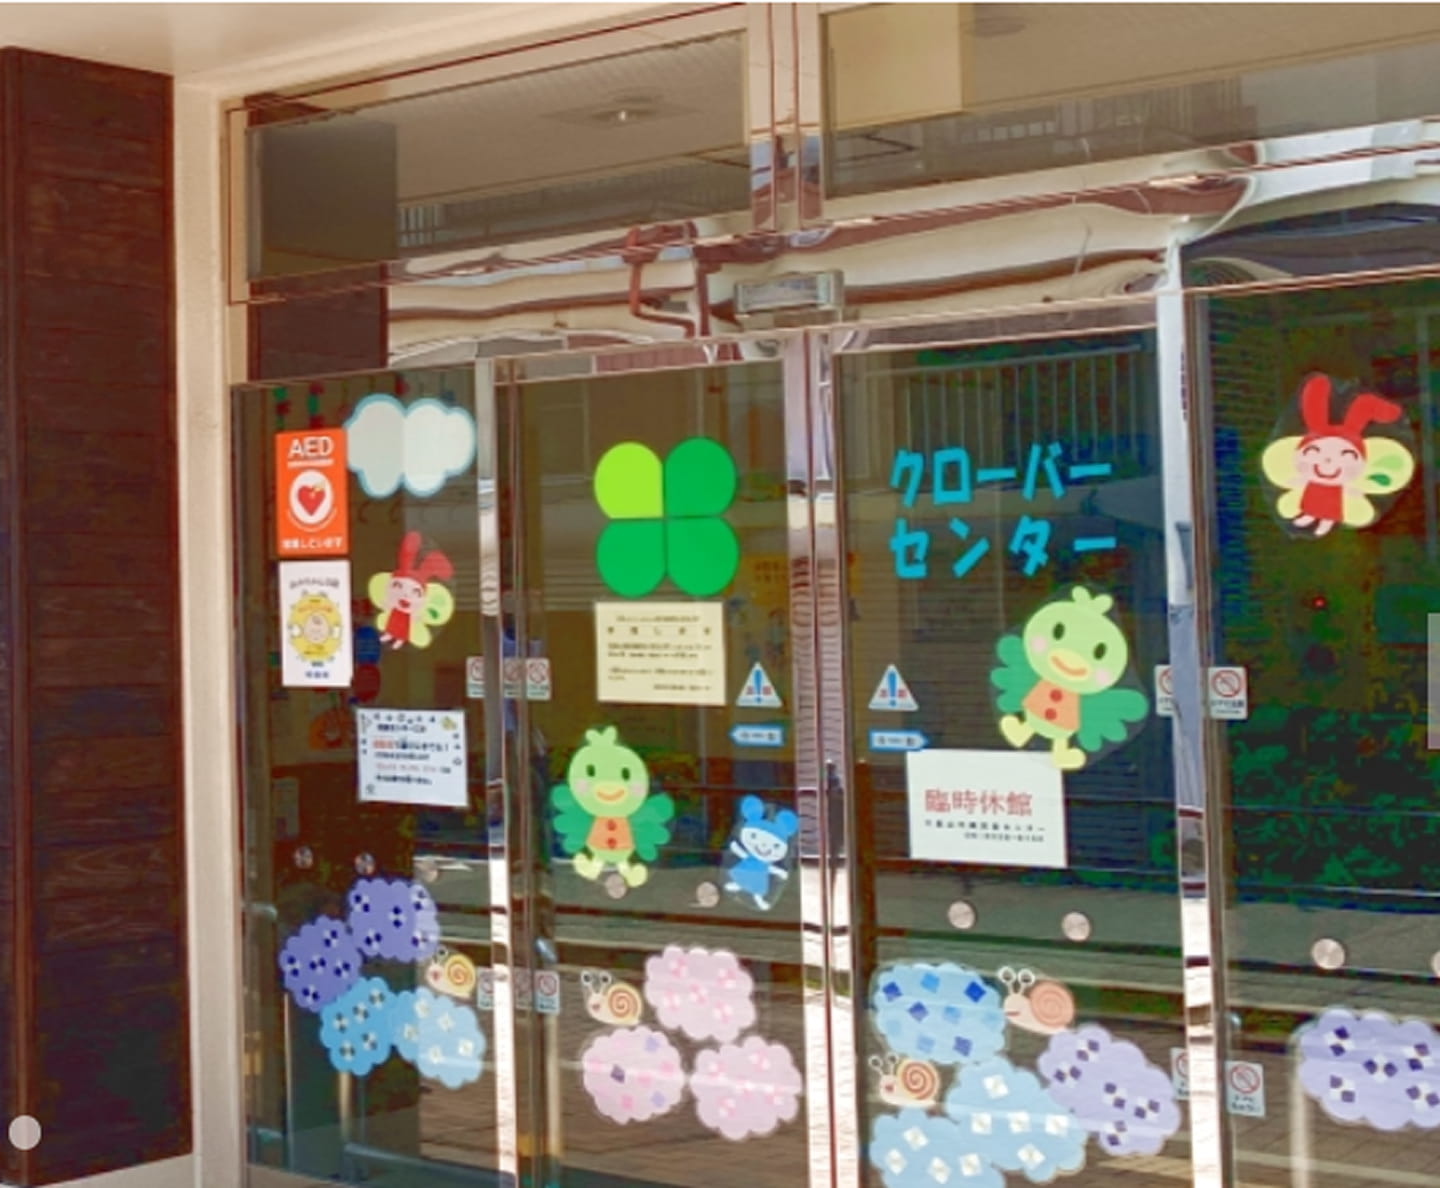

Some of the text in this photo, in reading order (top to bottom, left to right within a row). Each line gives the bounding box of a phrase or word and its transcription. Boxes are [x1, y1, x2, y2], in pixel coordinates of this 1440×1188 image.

[288, 436, 334, 459] AED
[889, 442, 1113, 508] クローバー
[889, 514, 1117, 579] センター
[925, 788, 1033, 816] 臨時休館
